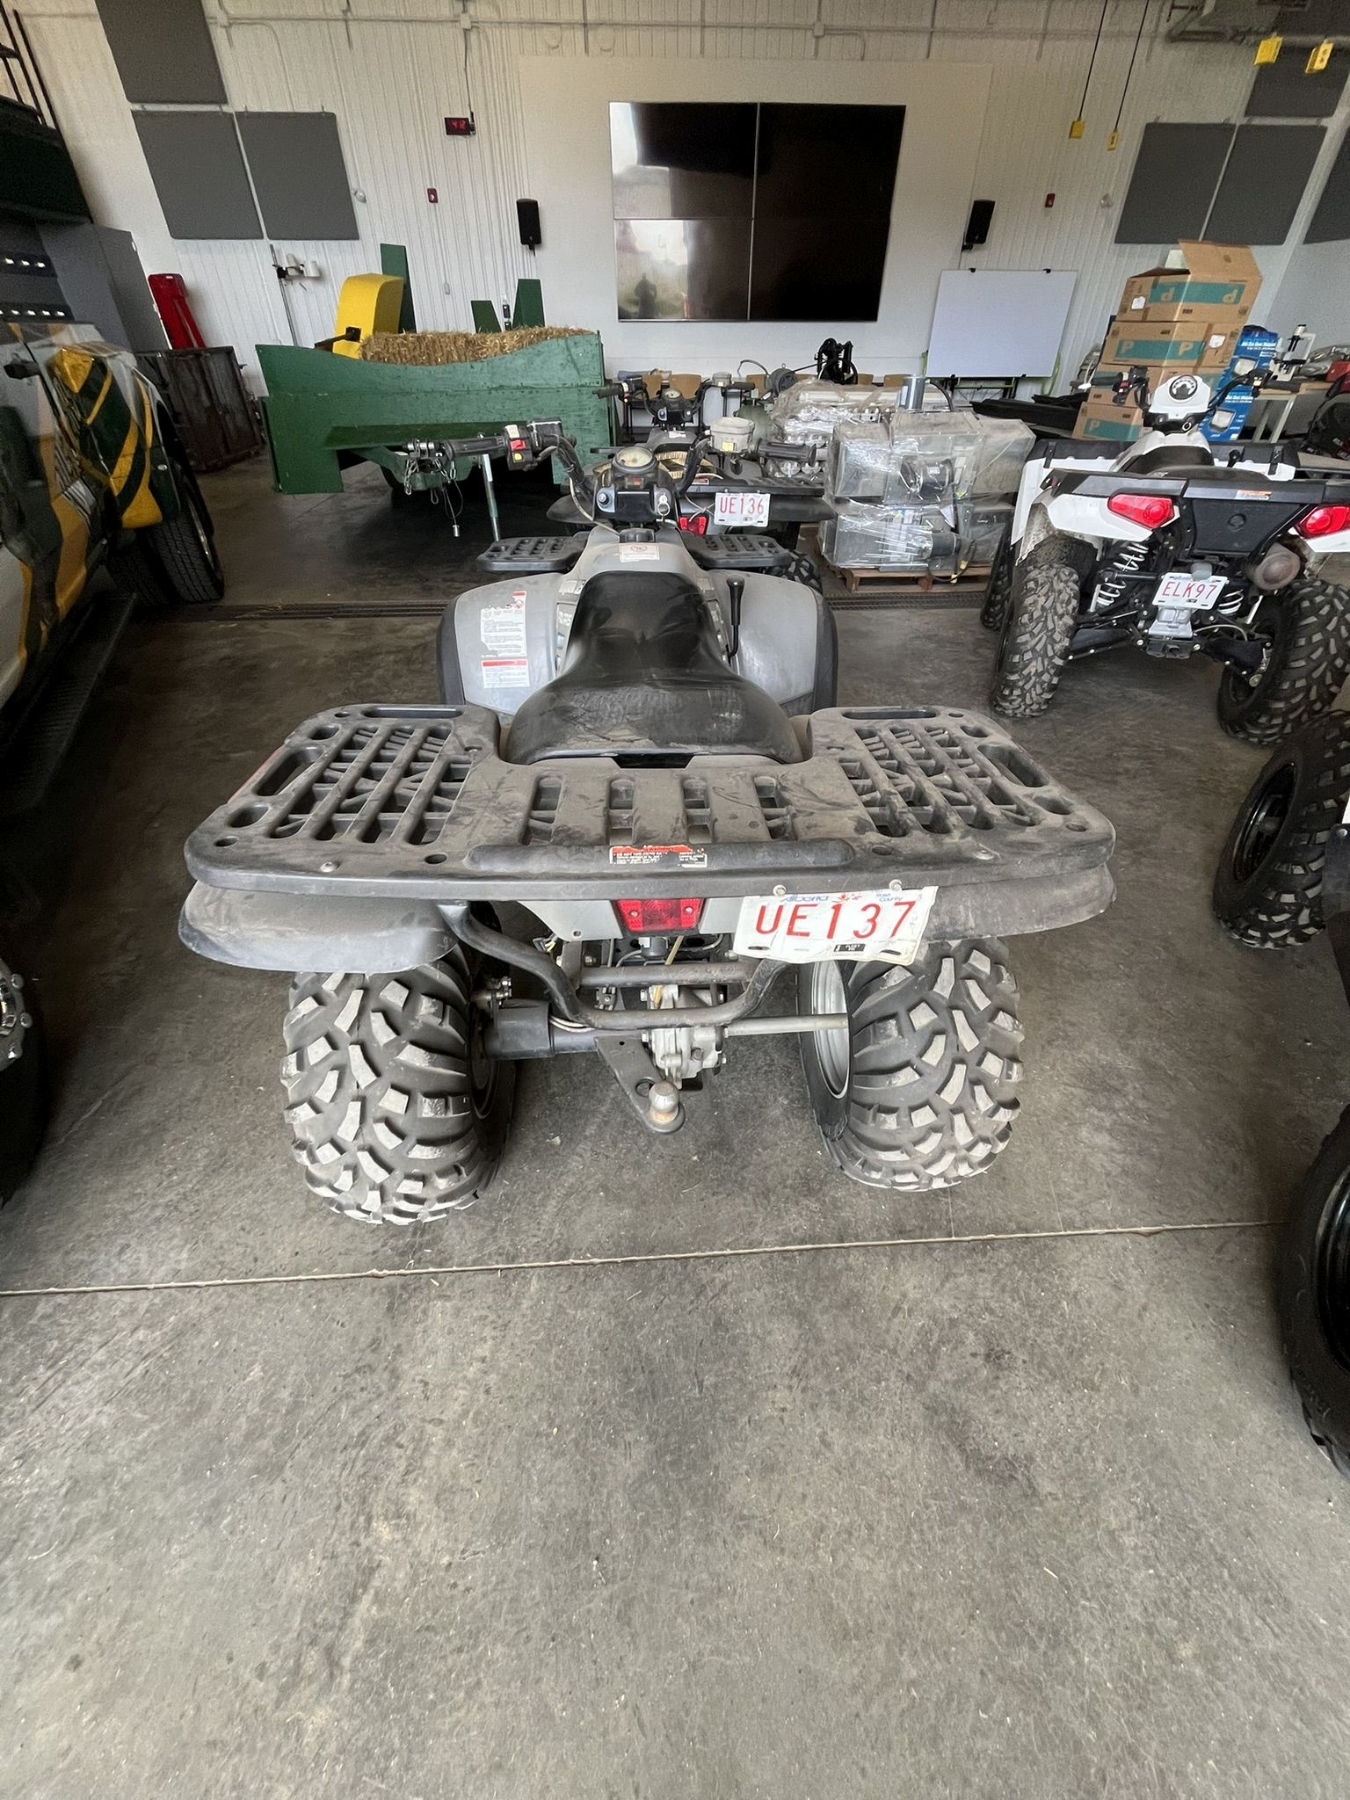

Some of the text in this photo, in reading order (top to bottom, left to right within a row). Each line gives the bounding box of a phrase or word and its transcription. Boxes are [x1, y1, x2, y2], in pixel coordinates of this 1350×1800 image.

[720, 497, 764, 515] UE136
[1162, 581, 1218, 600] ELK97
[755, 900, 916, 940] UE137
